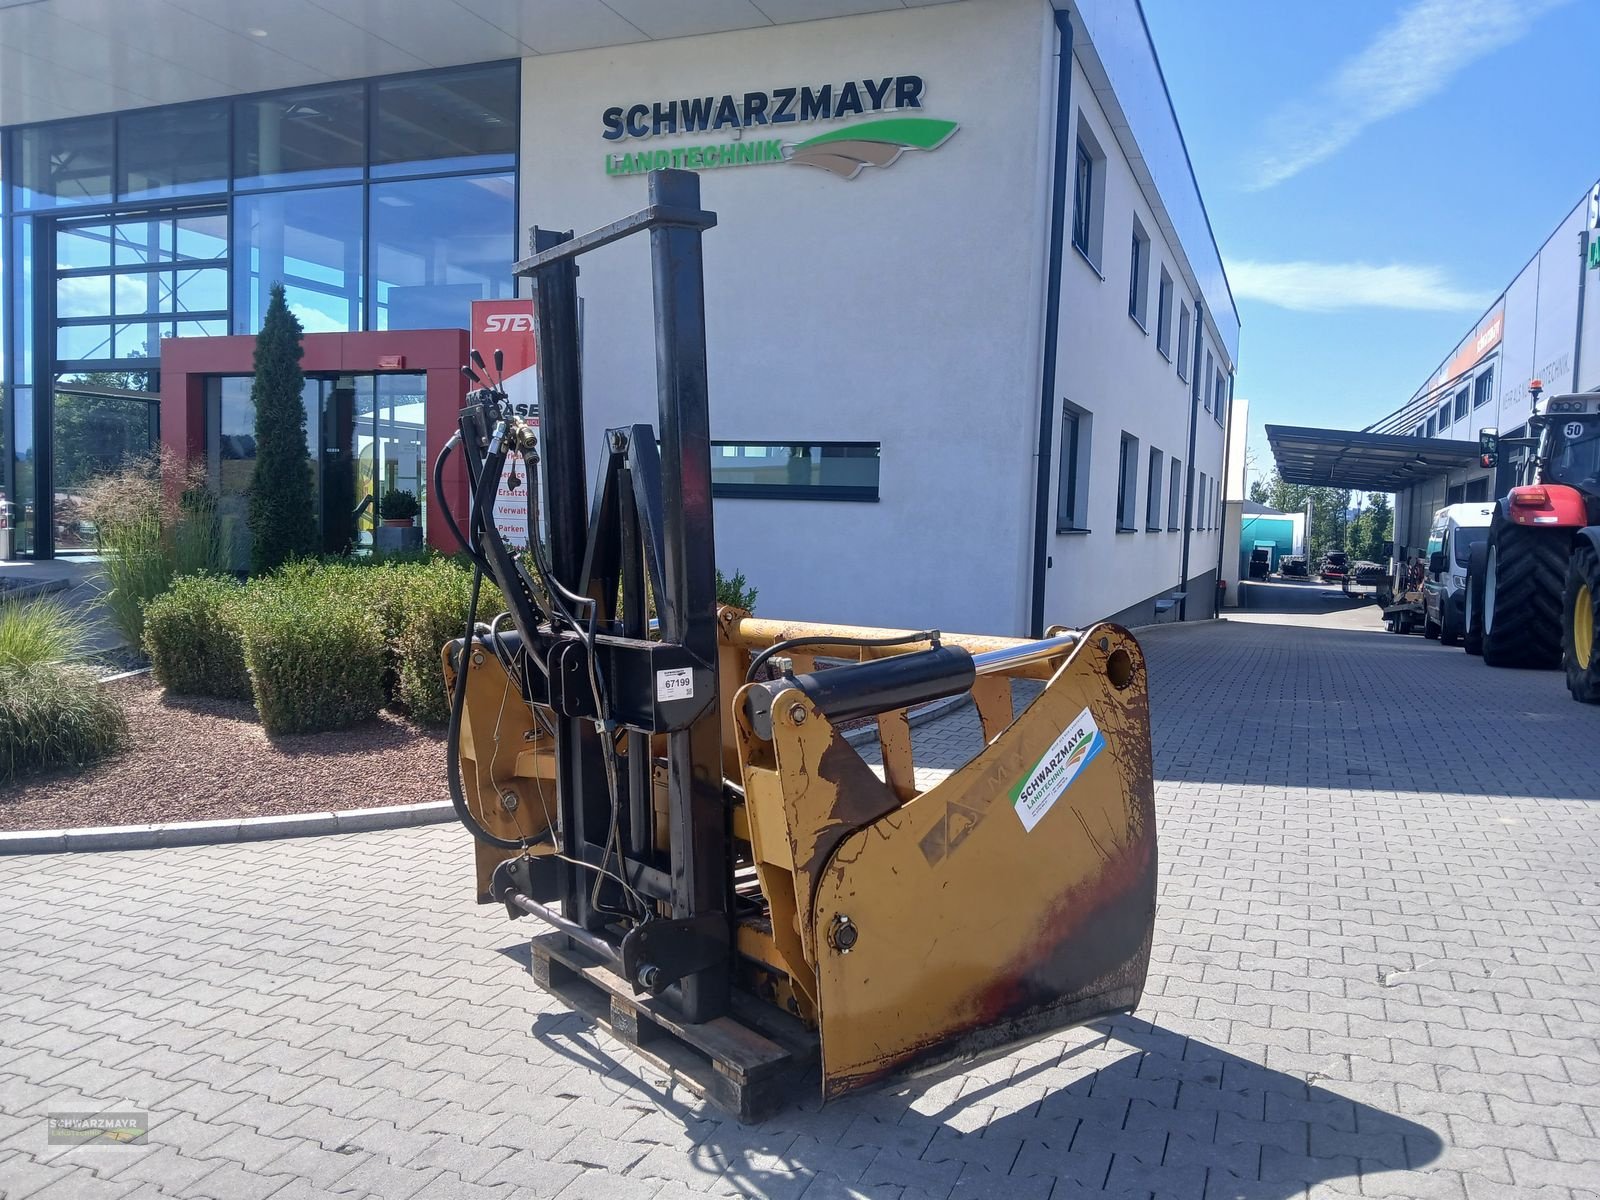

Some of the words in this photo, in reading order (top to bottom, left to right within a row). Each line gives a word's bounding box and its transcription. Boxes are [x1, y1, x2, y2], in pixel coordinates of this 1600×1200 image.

[602, 75, 923, 140] SCHWARZMAYR
[606, 139, 782, 176] LANDTECHNIK
[483, 313, 535, 332] STEY
[499, 403, 540, 418] ASE
[1566, 424, 1582, 436] 50
[498, 506, 528, 515] Verwalt
[498, 525, 524, 533] Parken
[665, 677, 690, 688] 67199
[1020, 728, 1085, 803] SCHWARZMAYR
[1026, 765, 1065, 810] LANDTECHNIK
